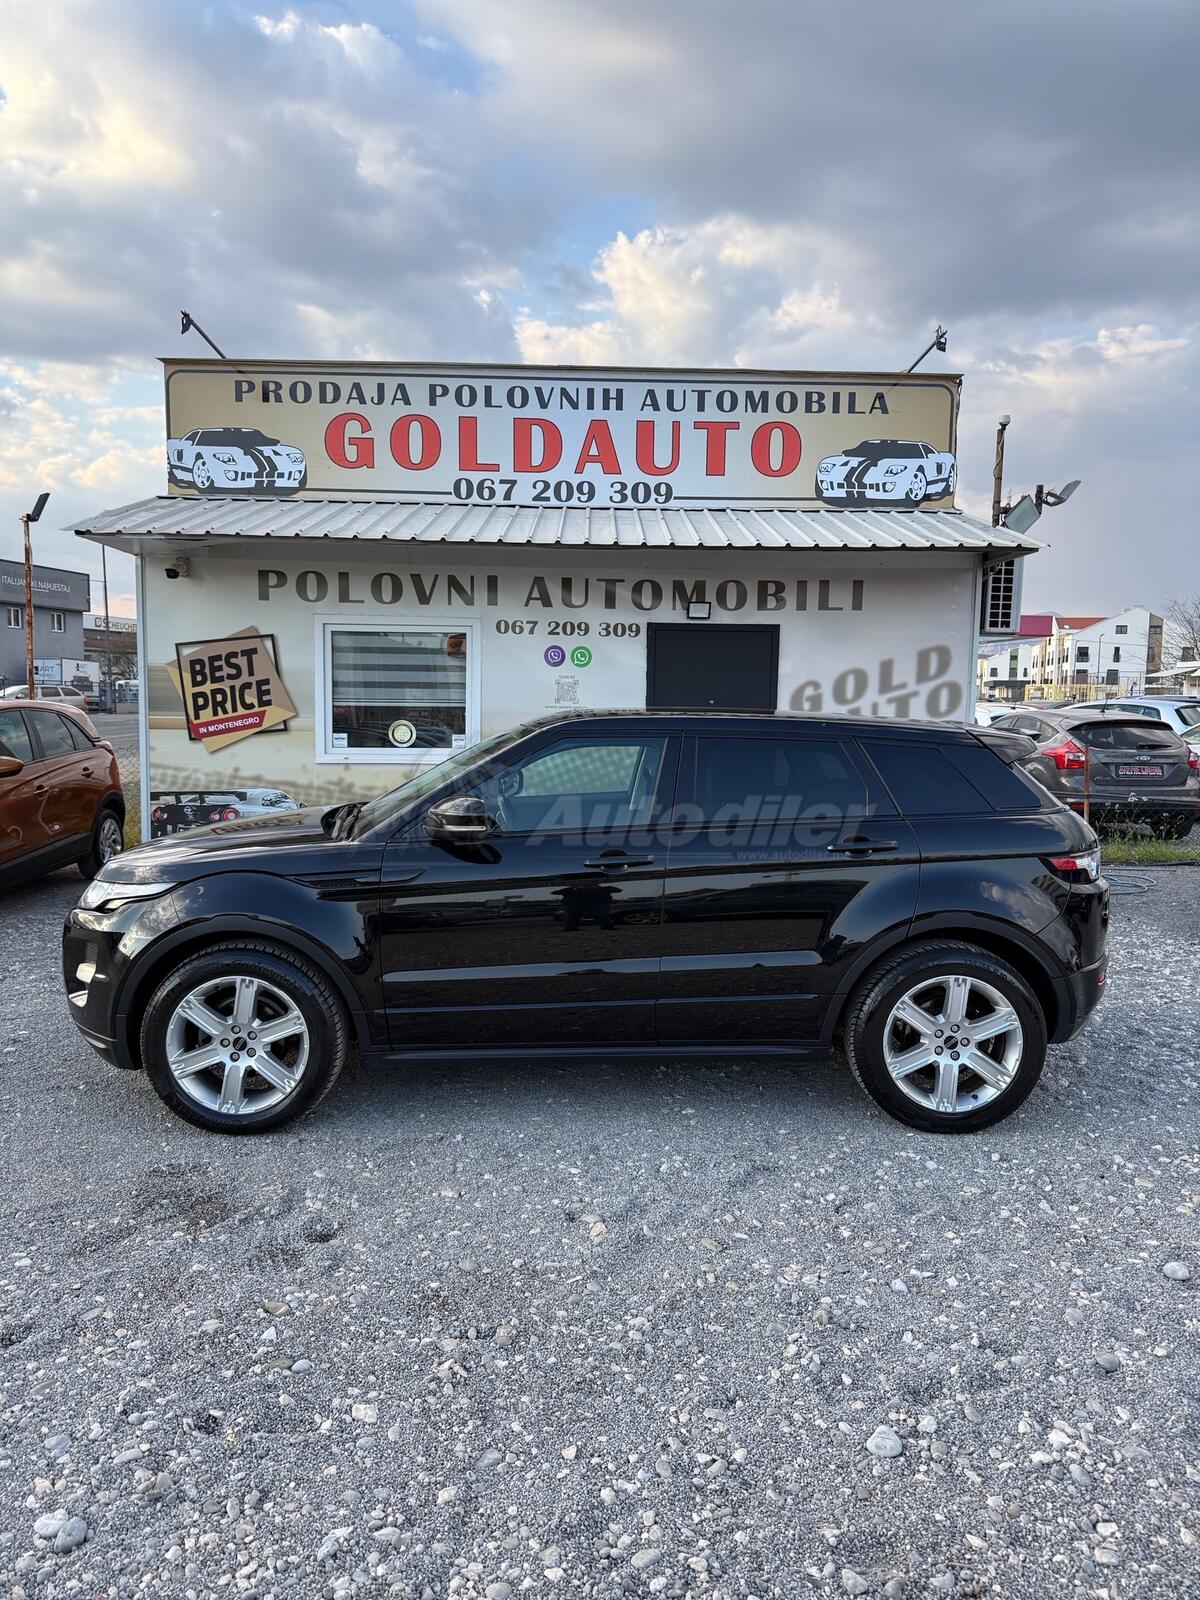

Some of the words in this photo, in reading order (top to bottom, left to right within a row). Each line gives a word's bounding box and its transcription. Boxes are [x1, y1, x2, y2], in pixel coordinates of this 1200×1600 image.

[234, 379, 412, 406] PRODAJA
[428, 383, 624, 411] POLOVNIH
[640, 388, 890, 415] AUTOMOBILA
[324, 412, 802, 478] GOLDAUTO
[453, 478, 517, 502] 067
[532, 479, 596, 504] 209
[609, 481, 673, 505] 309
[257, 569, 499, 606] POLOVNI
[524, 576, 864, 612] AUTOMOBILI
[495, 619, 538, 635] 067
[547, 620, 590, 637] 209
[598, 622, 641, 638] 309
[189, 647, 259, 688] BEST
[789, 644, 952, 712] GOLD
[191, 677, 273, 721] PRICE
[208, 716, 260, 732] MONTENEGRO
